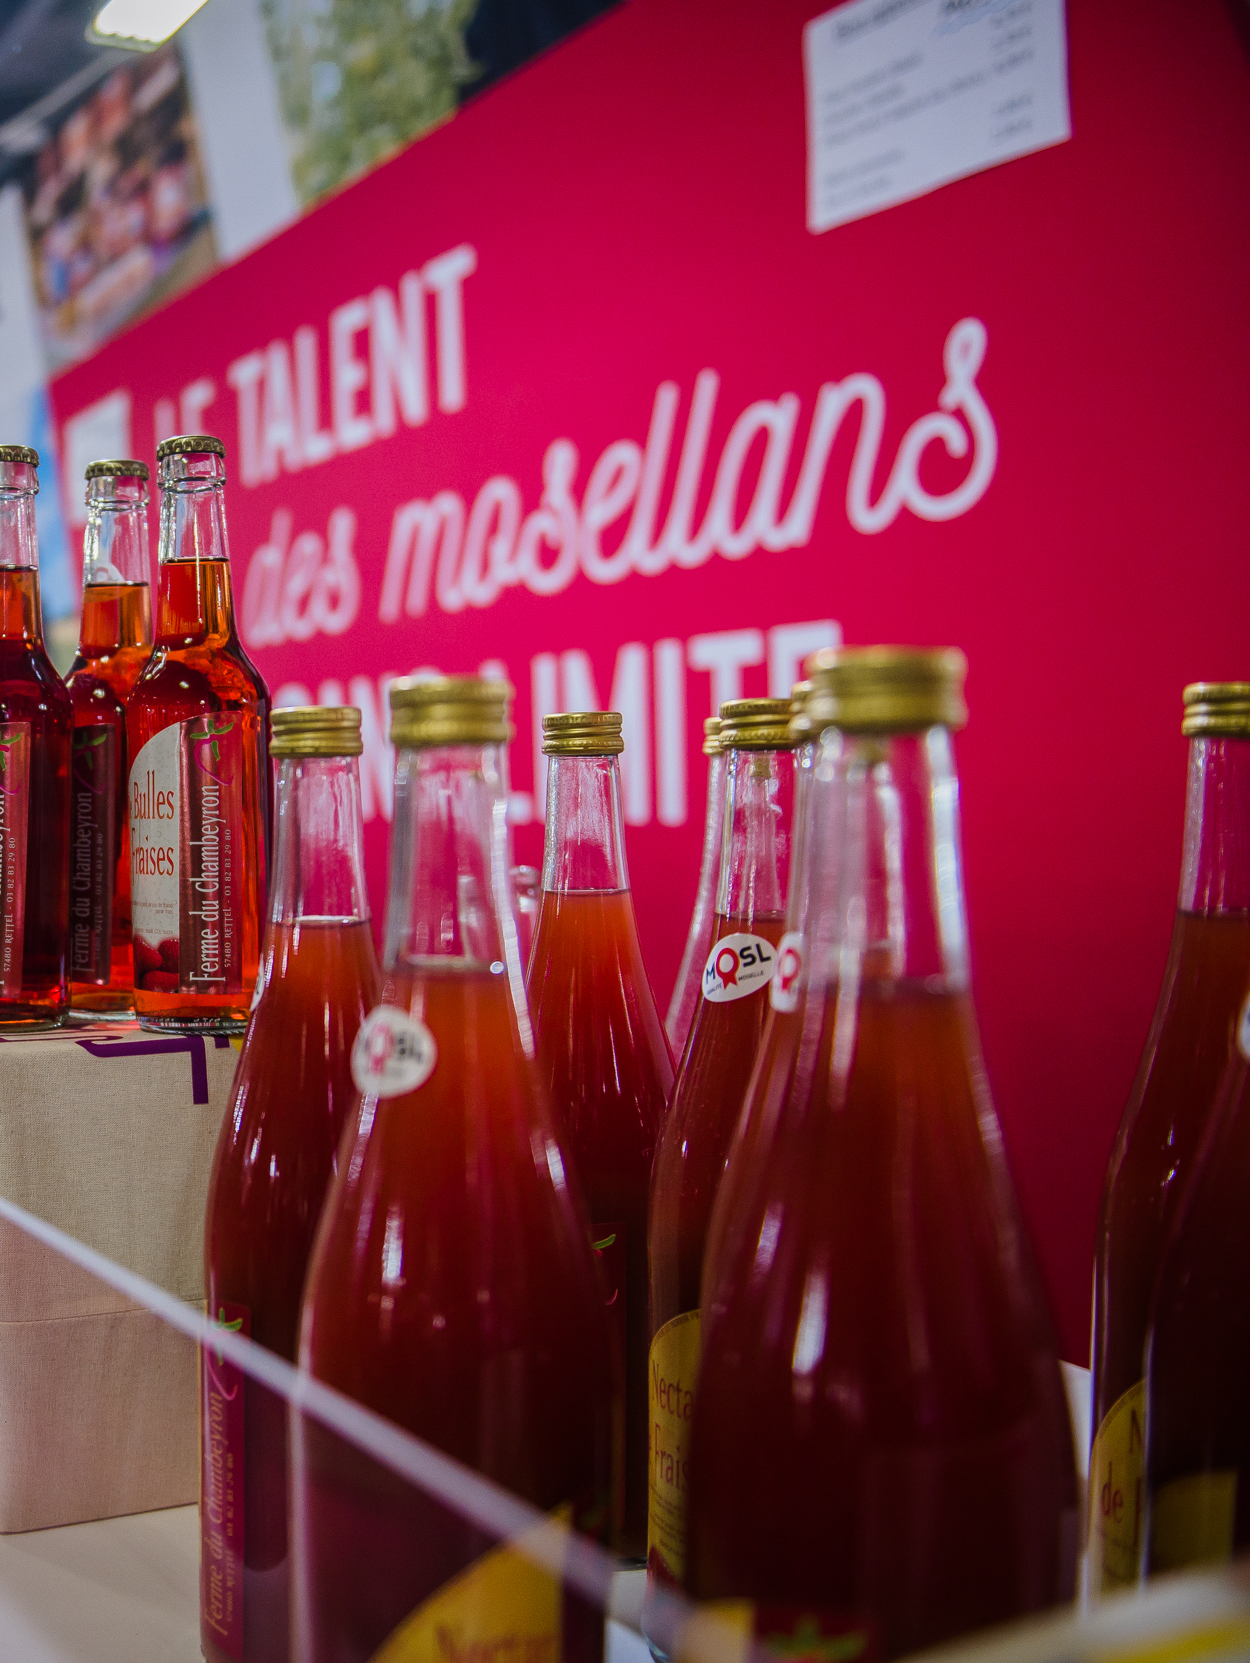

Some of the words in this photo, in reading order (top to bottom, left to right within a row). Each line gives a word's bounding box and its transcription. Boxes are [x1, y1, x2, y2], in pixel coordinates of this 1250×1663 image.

[226, 243, 477, 488] TALENT
[242, 503, 355, 650] des
[379, 317, 997, 623] mosellans
[483, 618, 842, 828] IMIT
[133, 770, 175, 820] Bulles
[8, 837, 16, 849] 80
[72, 792, 98, 891] Chambeyron
[188, 785, 227, 893] Chambeyron
[224, 828, 232, 840] 80
[8, 852, 16, 862] 29
[131, 828, 175, 887] Fraises
[224, 844, 232, 854] 29
[7, 866, 15, 876] 83
[224, 858, 232, 868] 83
[7, 879, 15, 889] 82
[224, 871, 232, 882] 82
[6, 892, 14, 903] 03
[224, 885, 232, 896] 03
[71, 897, 91, 917] du
[188, 900, 219, 921] du
[4, 913, 15, 944] RETTEL
[223, 907, 233, 938] RETTEL
[3, 947, 12, 972] 57480
[70, 923, 95, 972] Ferme
[189, 928, 226, 982] Ferme
[224, 942, 232, 968] 57480
[706, 943, 772, 990] MOSL
